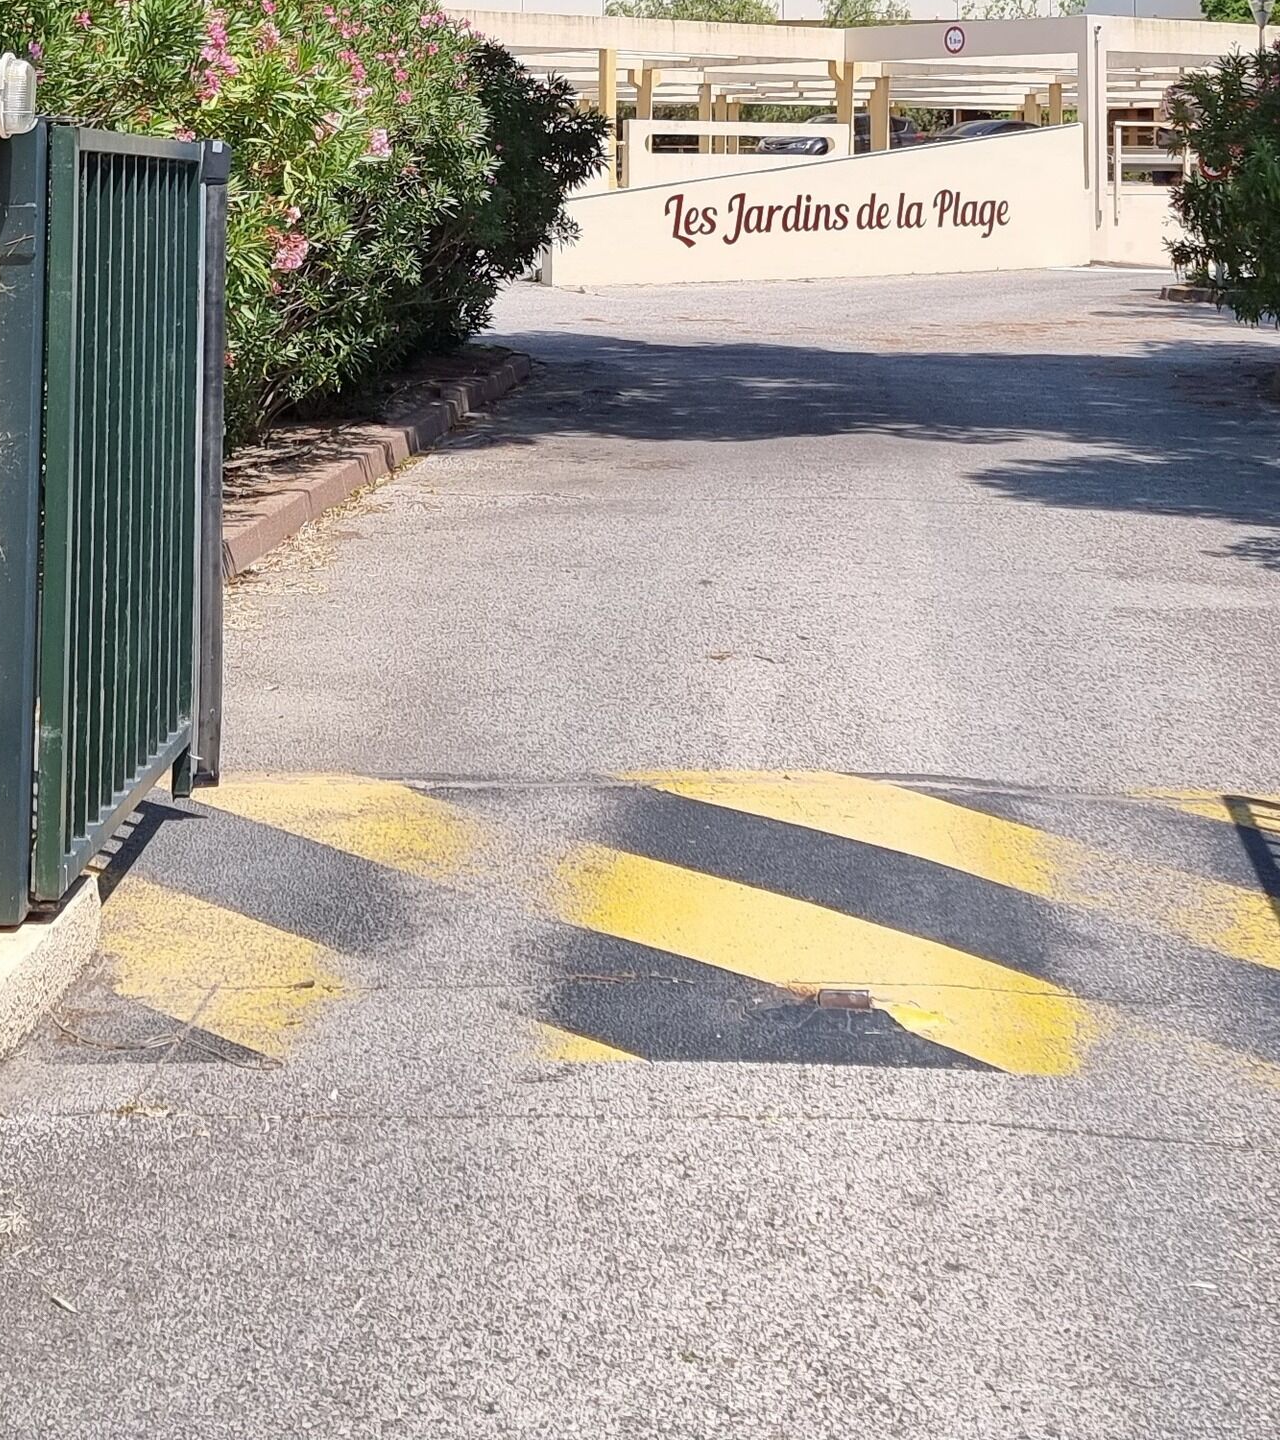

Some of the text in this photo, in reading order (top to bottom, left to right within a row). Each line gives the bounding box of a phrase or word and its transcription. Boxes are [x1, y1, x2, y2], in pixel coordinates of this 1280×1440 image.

[663, 189, 1010, 248] Les Jardins de la Plage
